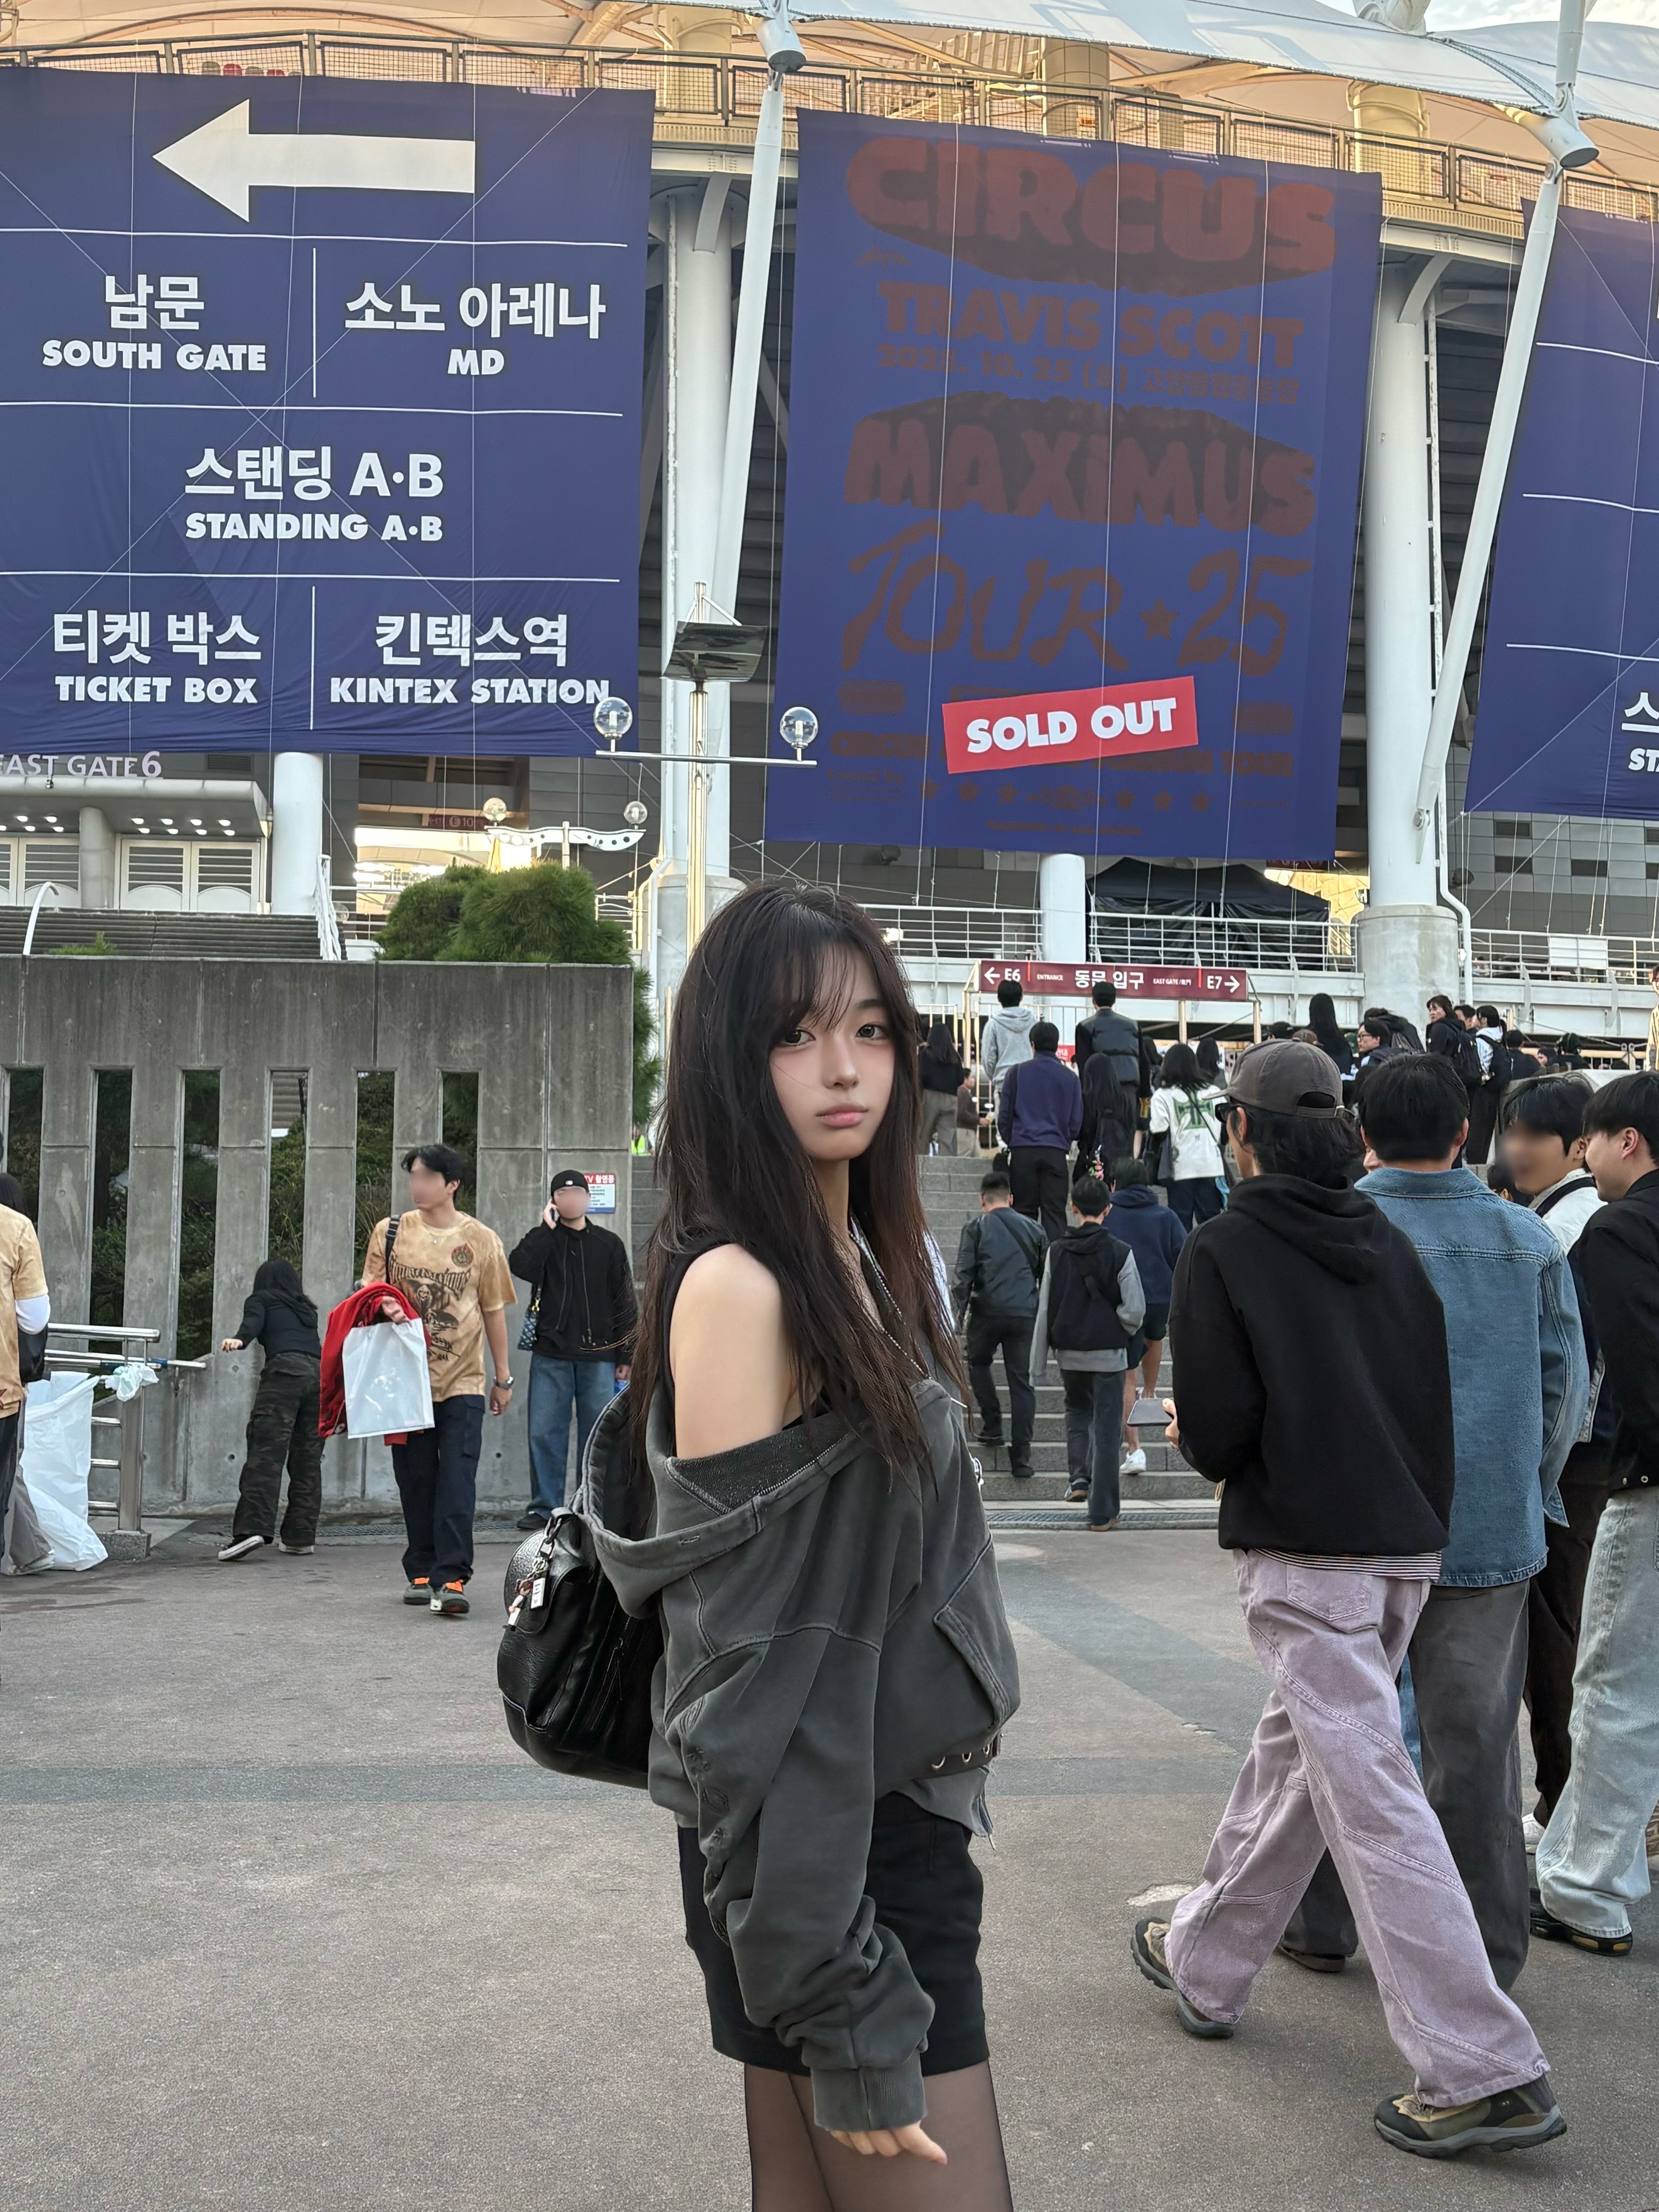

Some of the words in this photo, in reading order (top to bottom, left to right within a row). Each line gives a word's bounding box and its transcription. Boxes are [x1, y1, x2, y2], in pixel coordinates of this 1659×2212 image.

[846, 136, 1337, 274] CIRCUS
[106, 275, 204, 330] 남문
[345, 283, 445, 331] 소노
[460, 283, 606, 339] 아레나
[878, 281, 1100, 350] TRAVIS
[1119, 305, 1304, 368] SCOTT
[43, 340, 161, 369] SOUTH
[177, 344, 266, 371] GATE
[448, 349, 504, 375] MD
[980, 351, 1022, 377] 10.
[1031, 356, 1072, 383] 25
[185, 446, 331, 500] 스탠딩
[843, 413, 1314, 536] MAXIMUS
[186, 513, 368, 540] STANDING
[841, 519, 1129, 670] TOUR
[1176, 547, 1313, 678] 25
[54, 610, 151, 664] 티켓
[168, 612, 261, 665] 박스
[376, 613, 567, 666] 킨텍스역
[55, 676, 171, 702] TICKET
[184, 678, 258, 703] BOX
[331, 678, 458, 703] KINTEX
[471, 679, 609, 704] STATION
[967, 711, 1077, 753] SOLD
[1091, 698, 1176, 738] OUT
[68, 755, 137, 777] GATE
[142, 751, 162, 778] 6
[1629, 748, 1659, 772] ST
[1005, 968, 1021, 982] E6
[1113, 971, 1144, 990] 입구
[1207, 975, 1222, 989] E7
